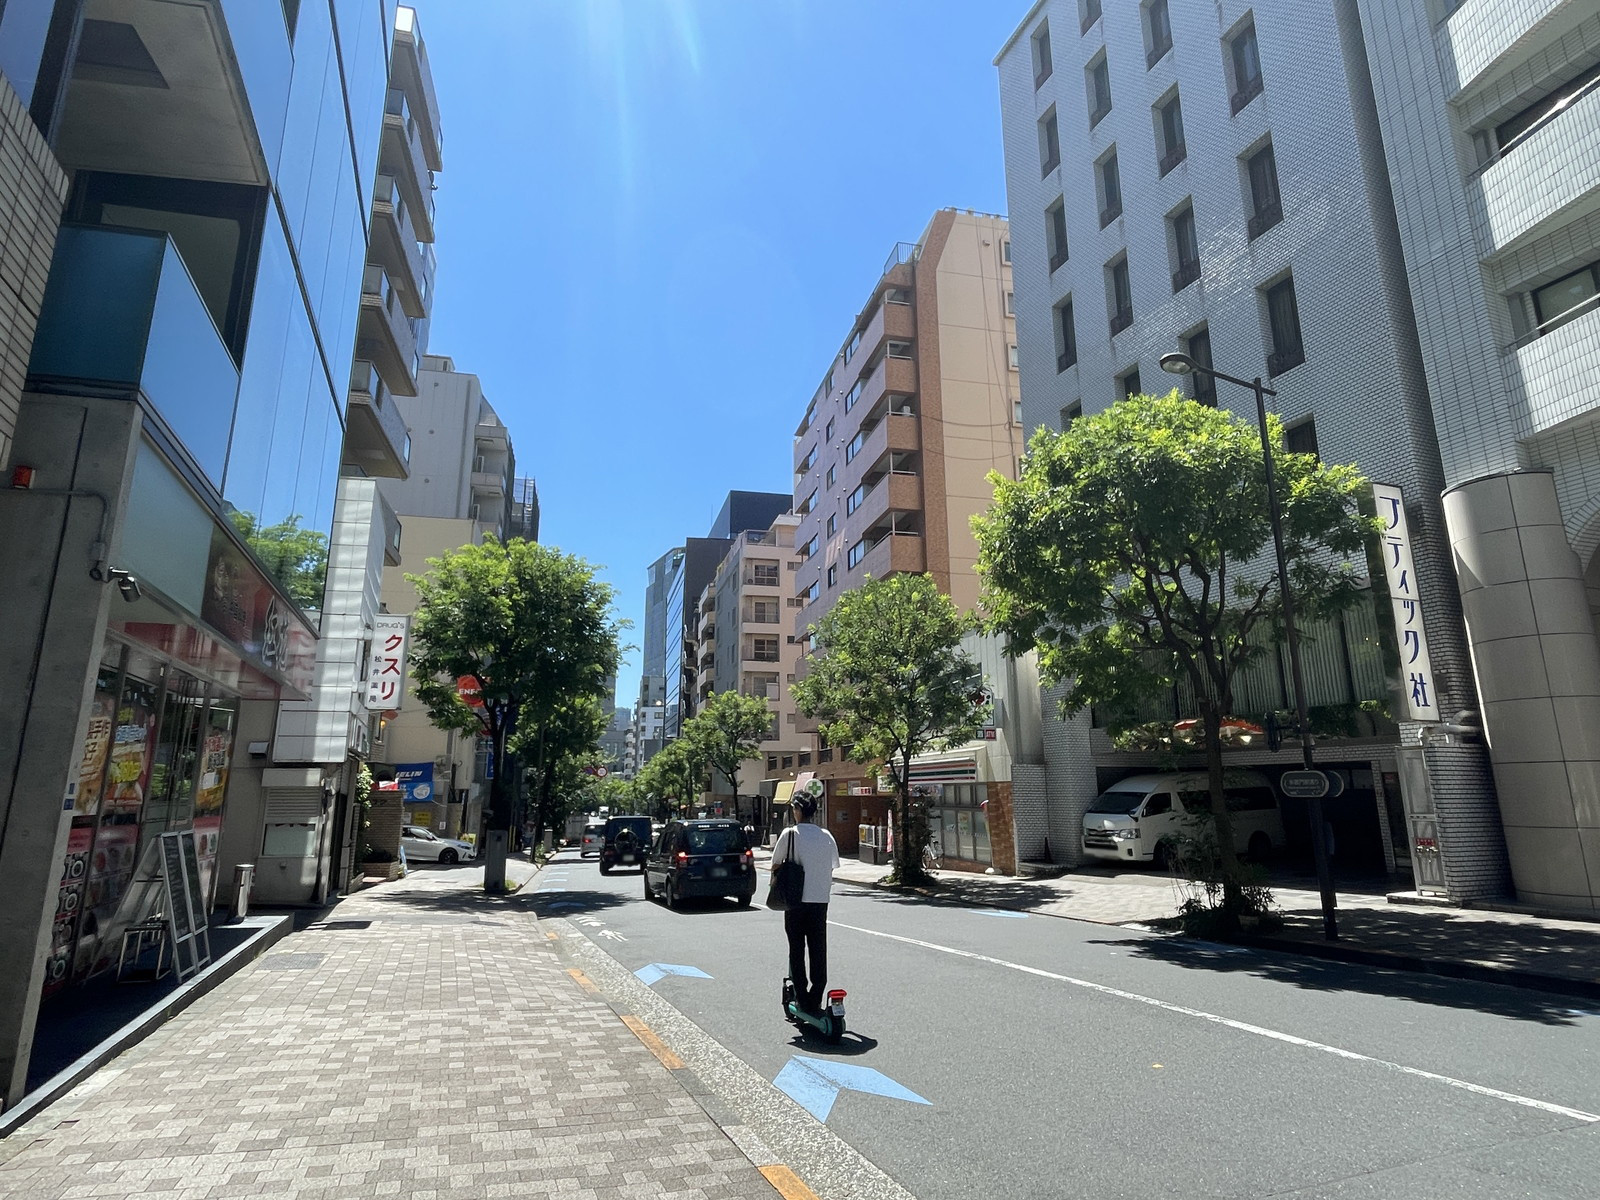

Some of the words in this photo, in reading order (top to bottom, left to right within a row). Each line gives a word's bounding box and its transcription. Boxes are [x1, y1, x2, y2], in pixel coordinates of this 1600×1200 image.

[381, 634, 403, 701] クスリ
[1379, 496, 1430, 708] ブティック社
